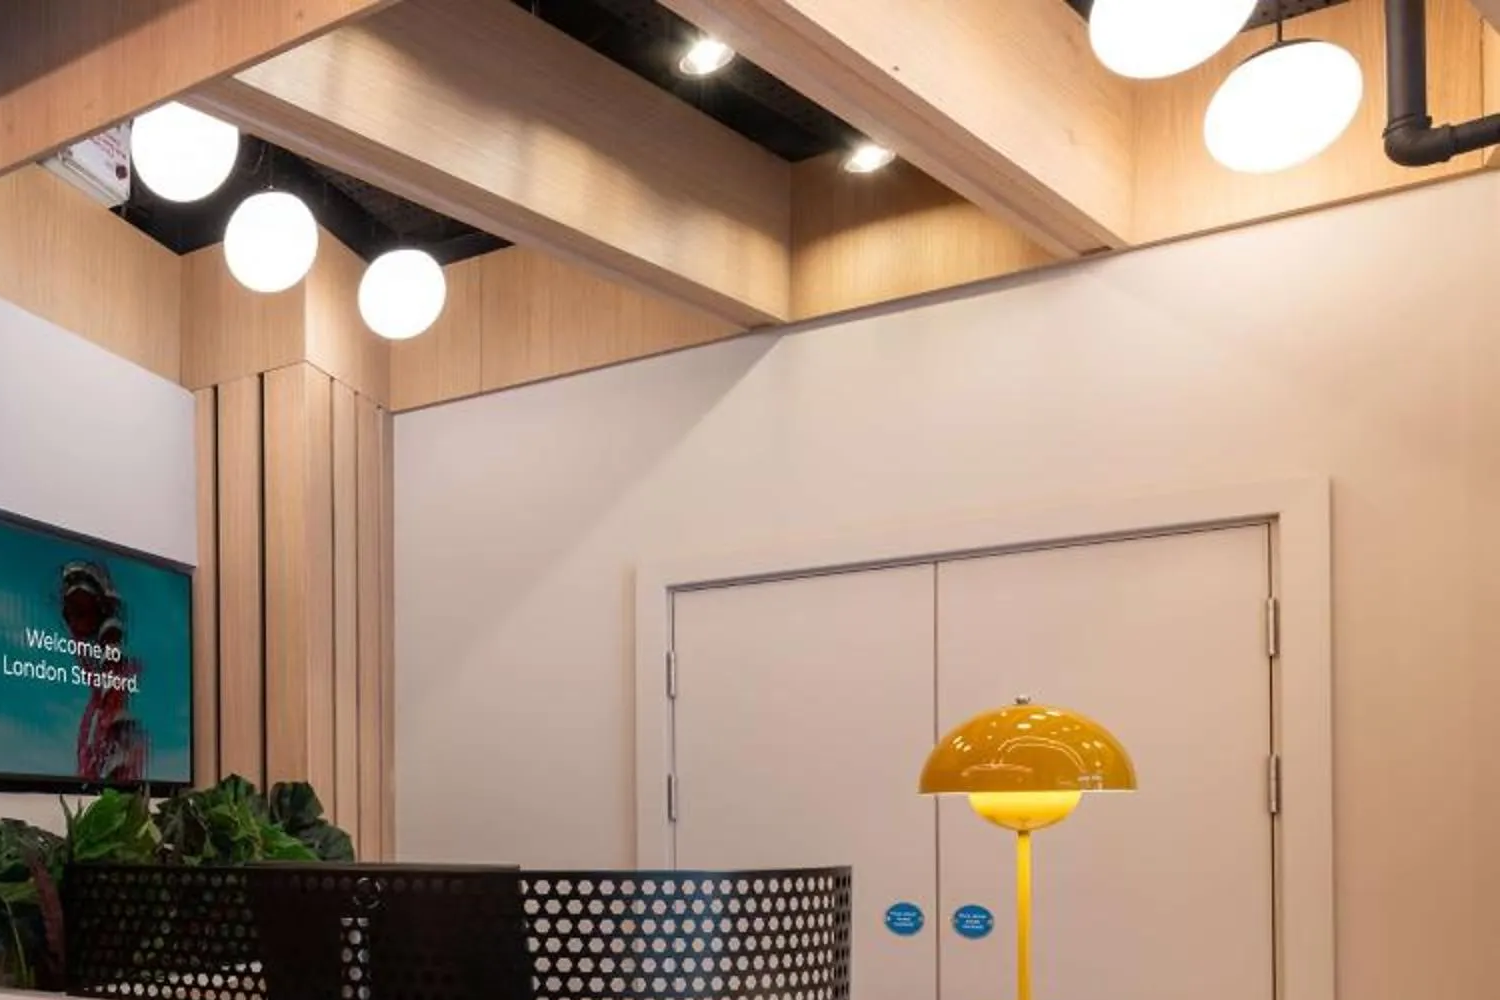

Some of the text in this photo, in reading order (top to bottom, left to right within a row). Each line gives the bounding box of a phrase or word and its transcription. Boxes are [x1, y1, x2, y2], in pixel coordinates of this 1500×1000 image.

[26, 627, 121, 662] Welcome to
[3, 654, 67, 683] London
